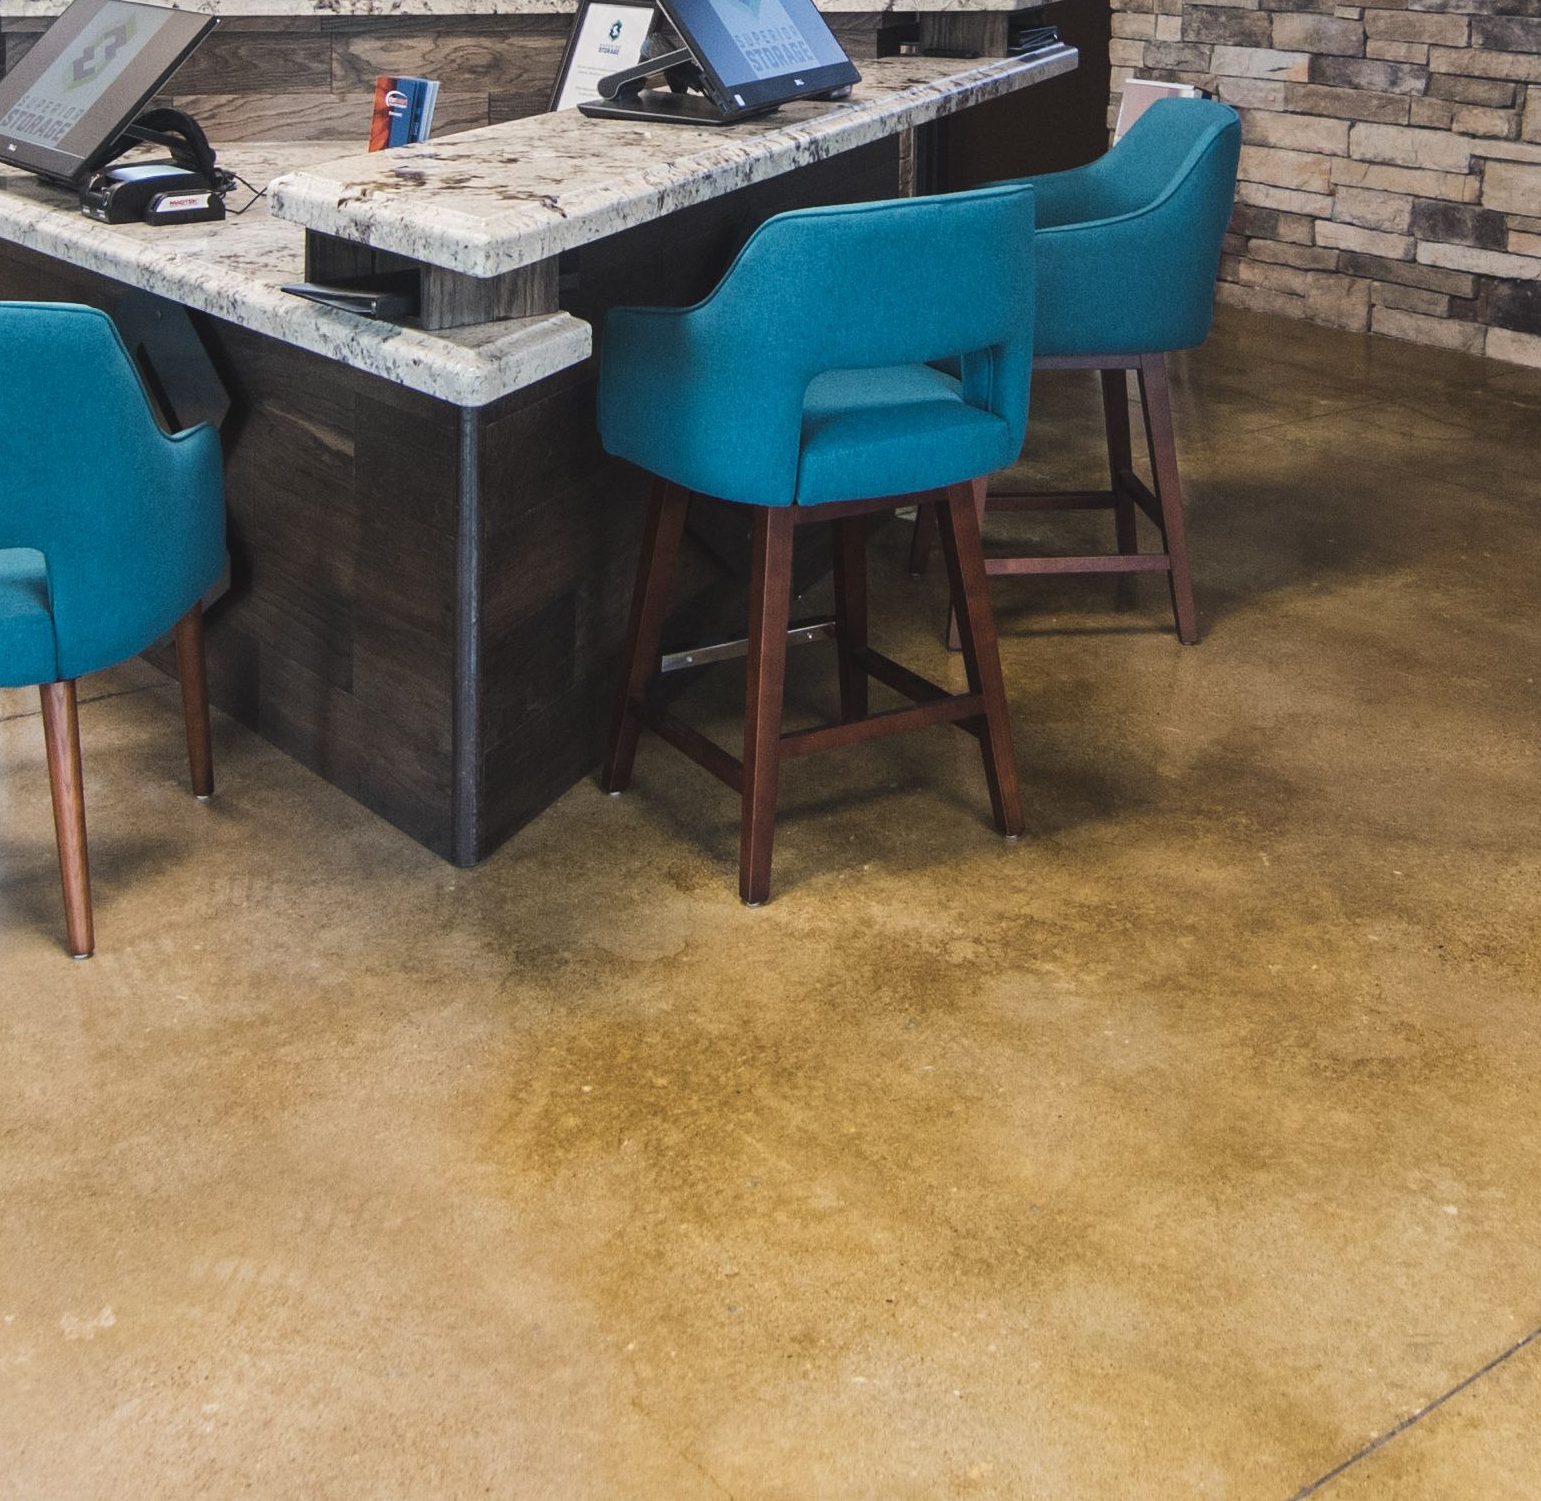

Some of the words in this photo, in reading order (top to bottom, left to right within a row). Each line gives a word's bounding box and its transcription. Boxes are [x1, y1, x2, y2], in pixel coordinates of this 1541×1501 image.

[734, 25, 796, 49] SUPERIOR
[745, 40, 815, 72] STORAGE
[16, 95, 85, 120] SUPERIOR
[1, 109, 74, 141] STORAGE
